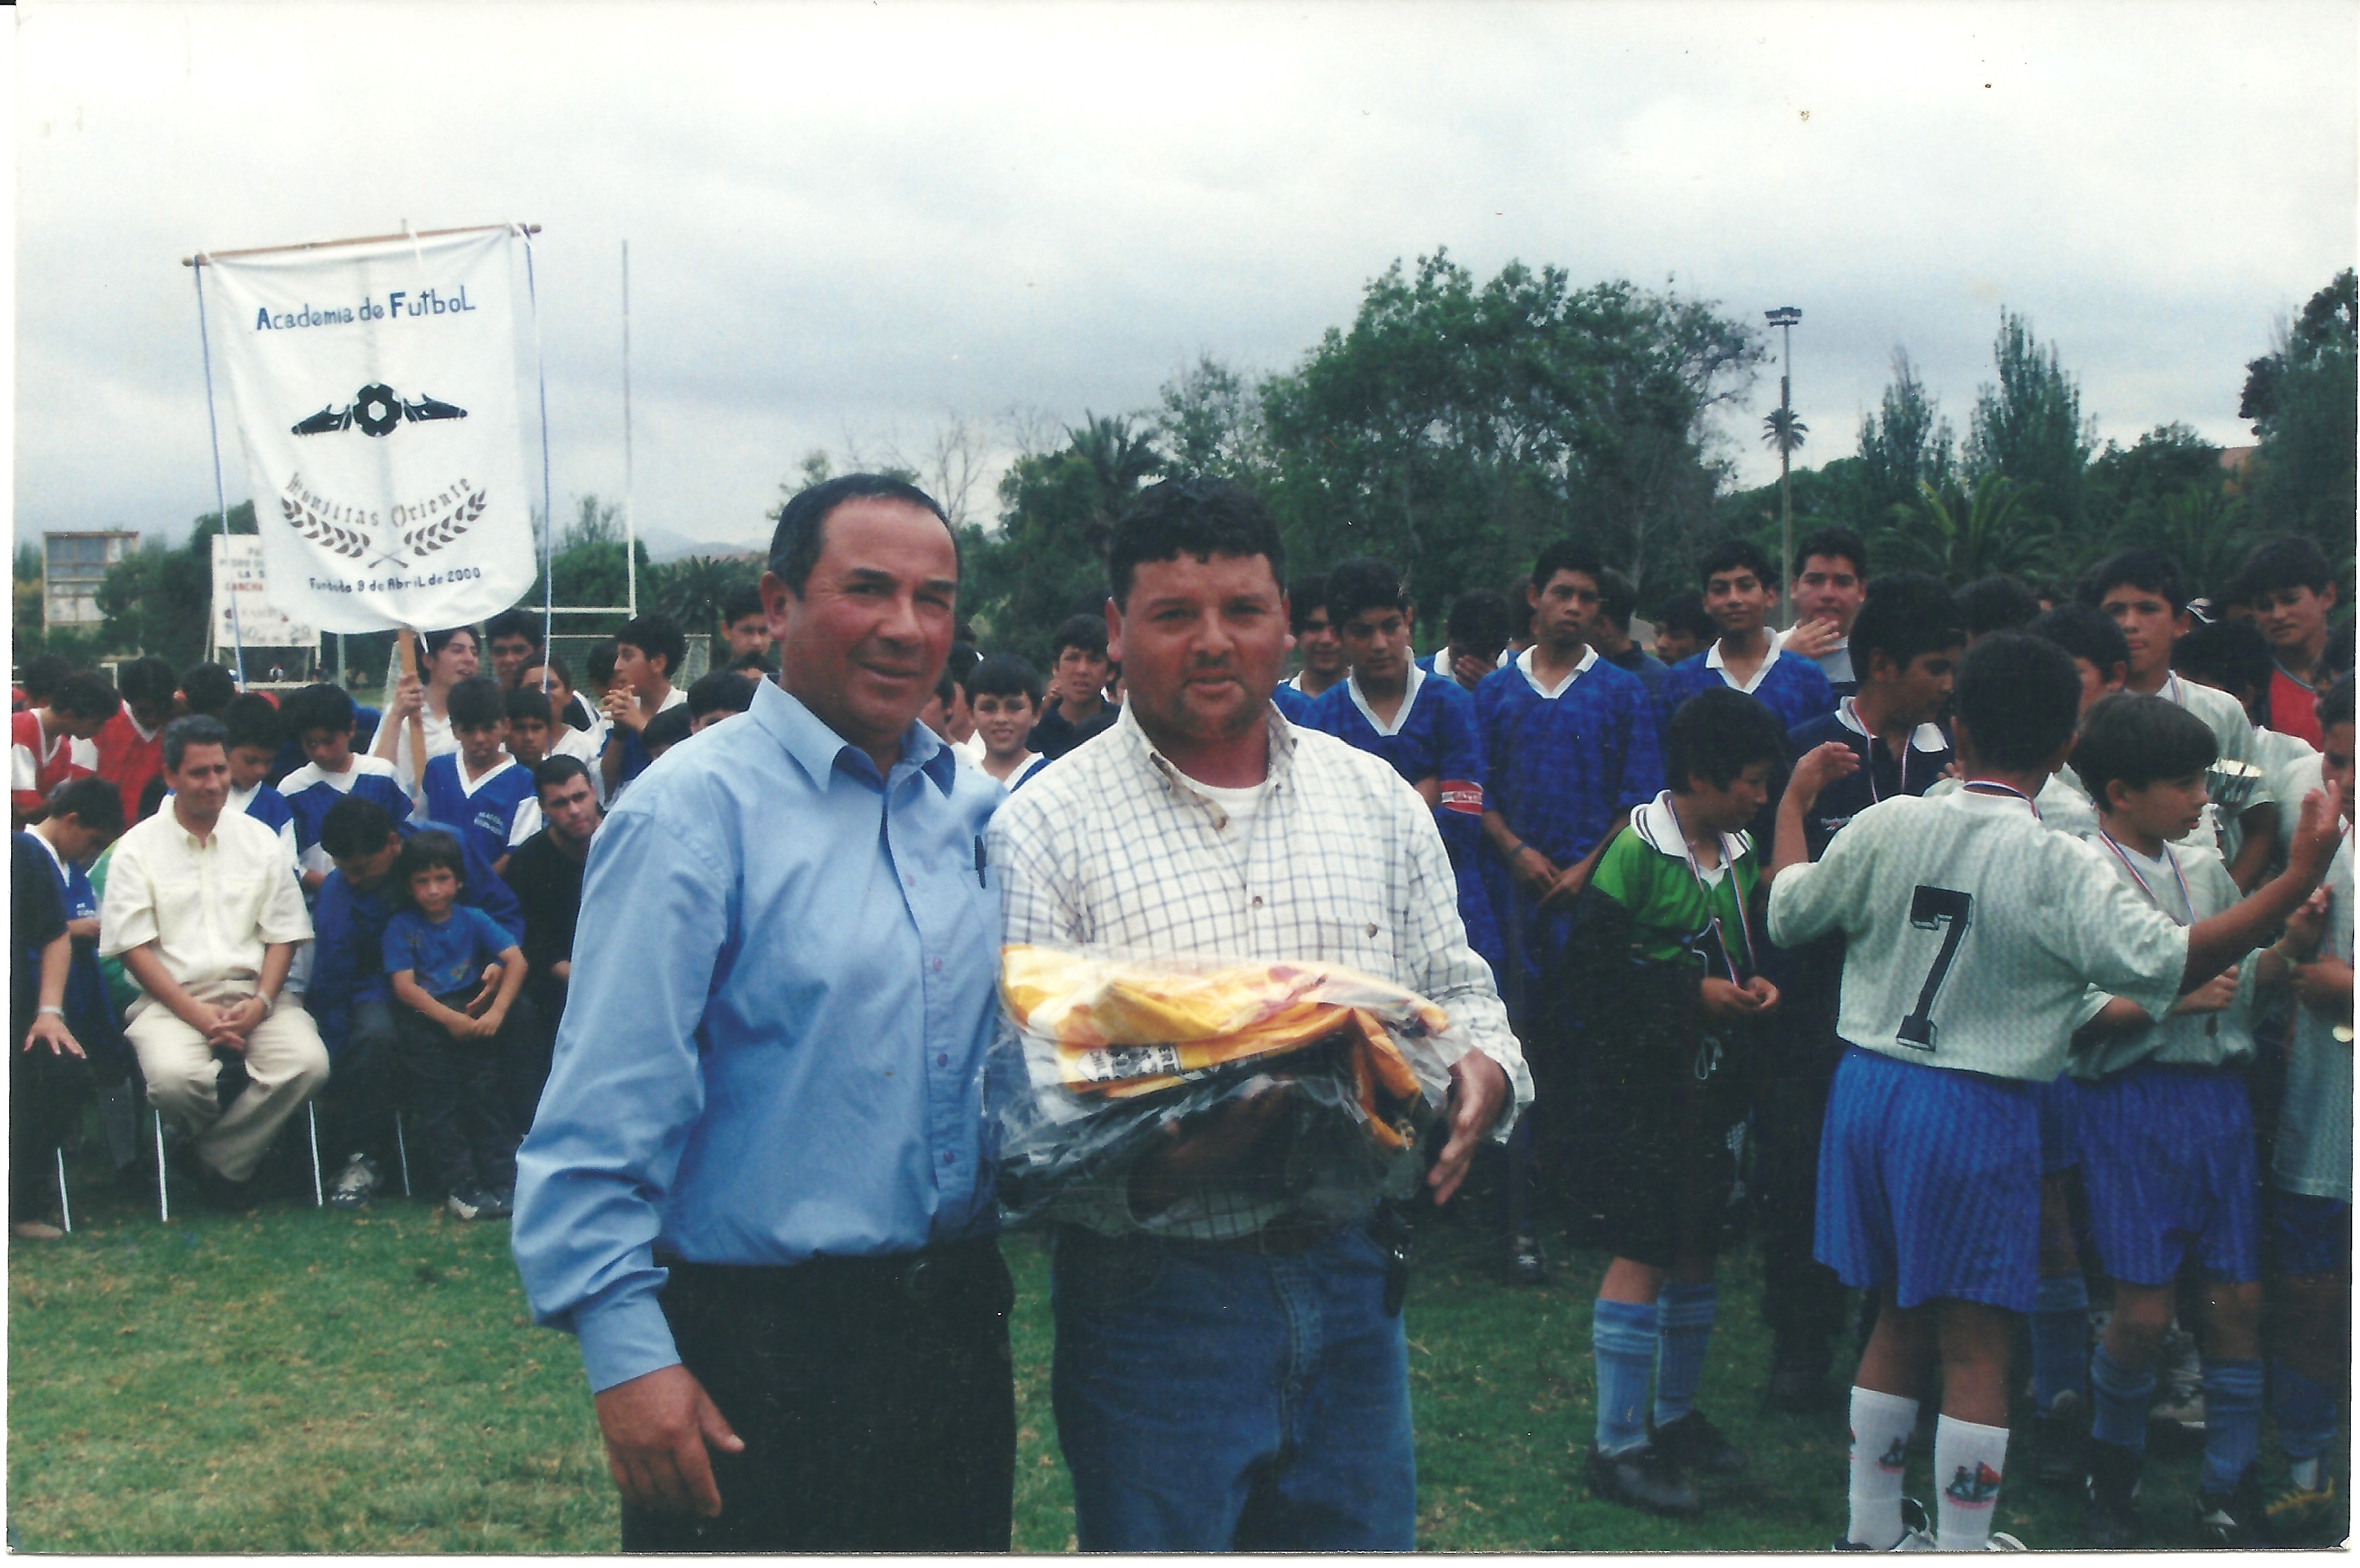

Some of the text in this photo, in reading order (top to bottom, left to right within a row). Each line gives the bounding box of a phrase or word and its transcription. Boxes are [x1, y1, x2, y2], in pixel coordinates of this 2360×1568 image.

[257, 303, 354, 330] Academia
[360, 297, 384, 321] de
[358, 579, 365, 592] 9
[369, 579, 384, 592] de
[428, 572, 443, 586] de
[447, 566, 481, 584] 2000
[1895, 884, 1974, 1052] 7
